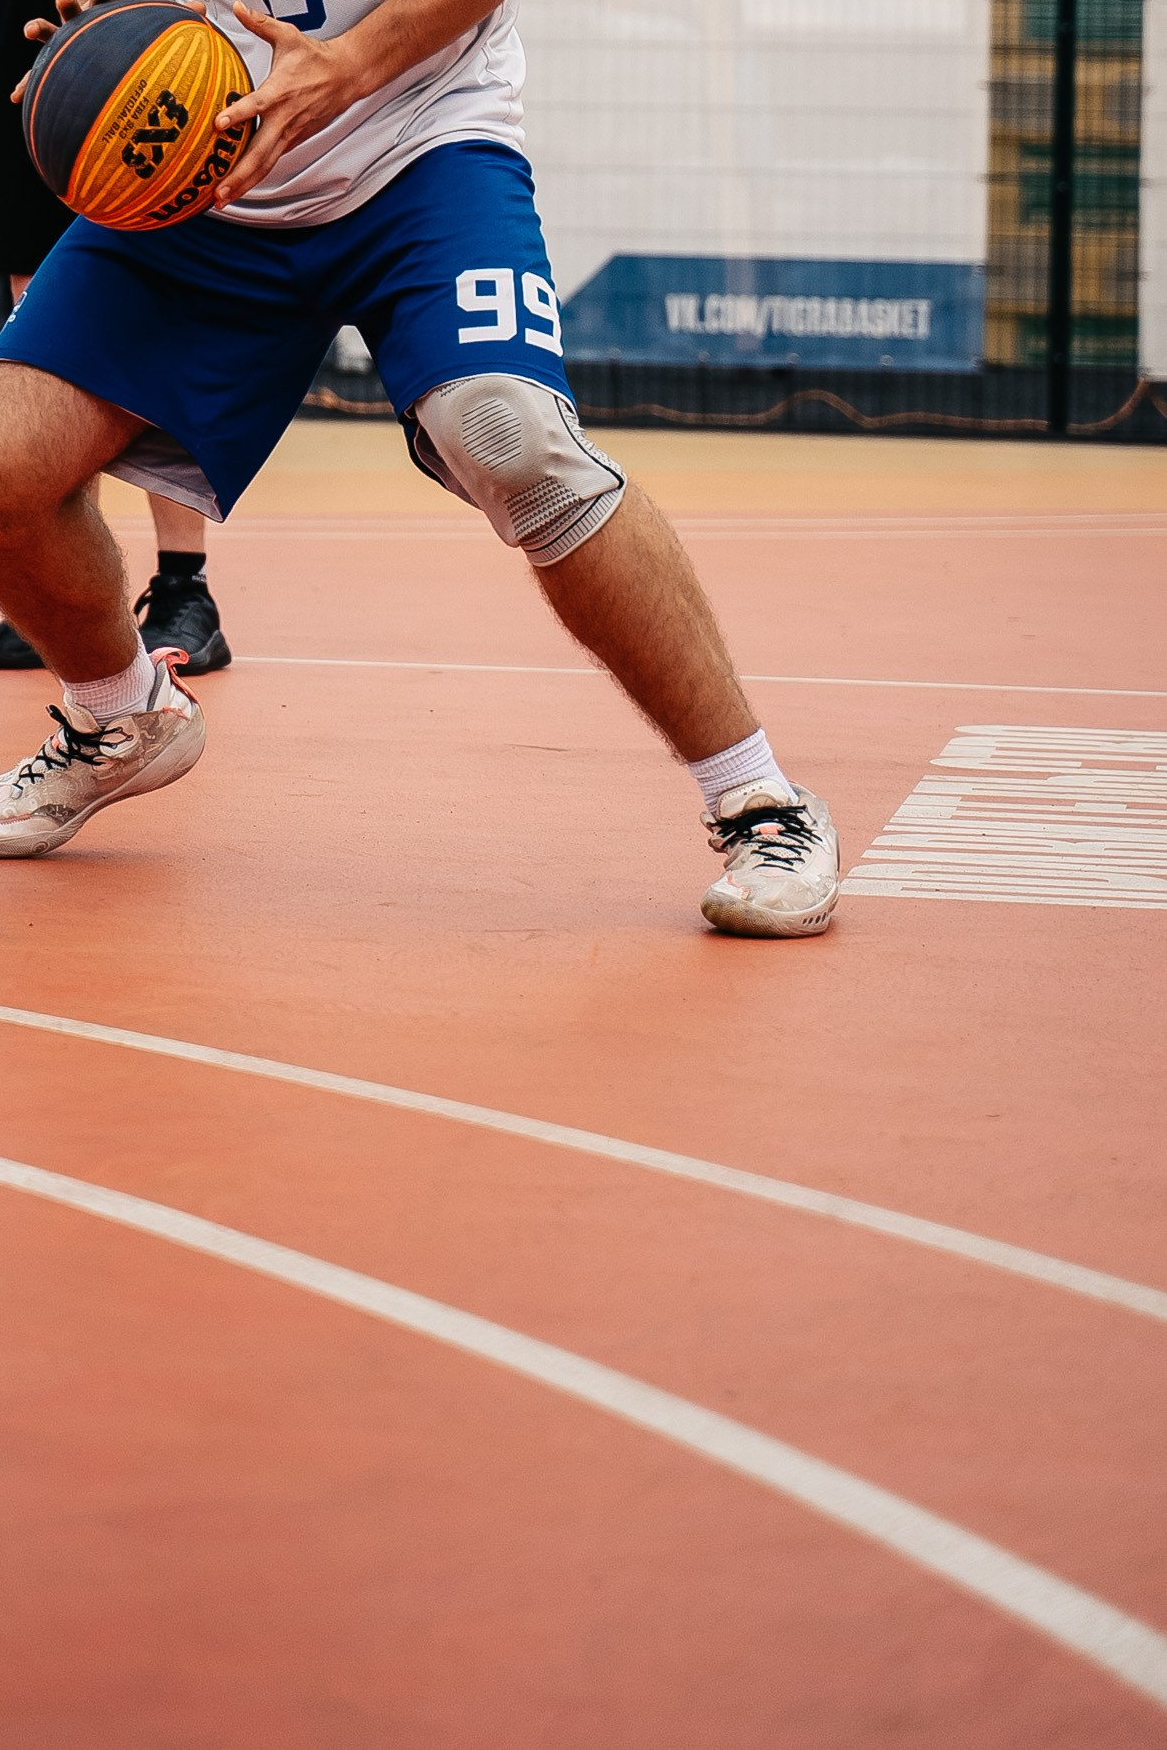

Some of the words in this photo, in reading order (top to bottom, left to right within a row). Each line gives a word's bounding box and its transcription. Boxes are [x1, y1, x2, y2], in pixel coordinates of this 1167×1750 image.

[117, 78, 148, 121] OFFICIAL
[131, 96, 150, 120] FIBA
[101, 121, 121, 143] BALL
[456, 268, 564, 357] 99
